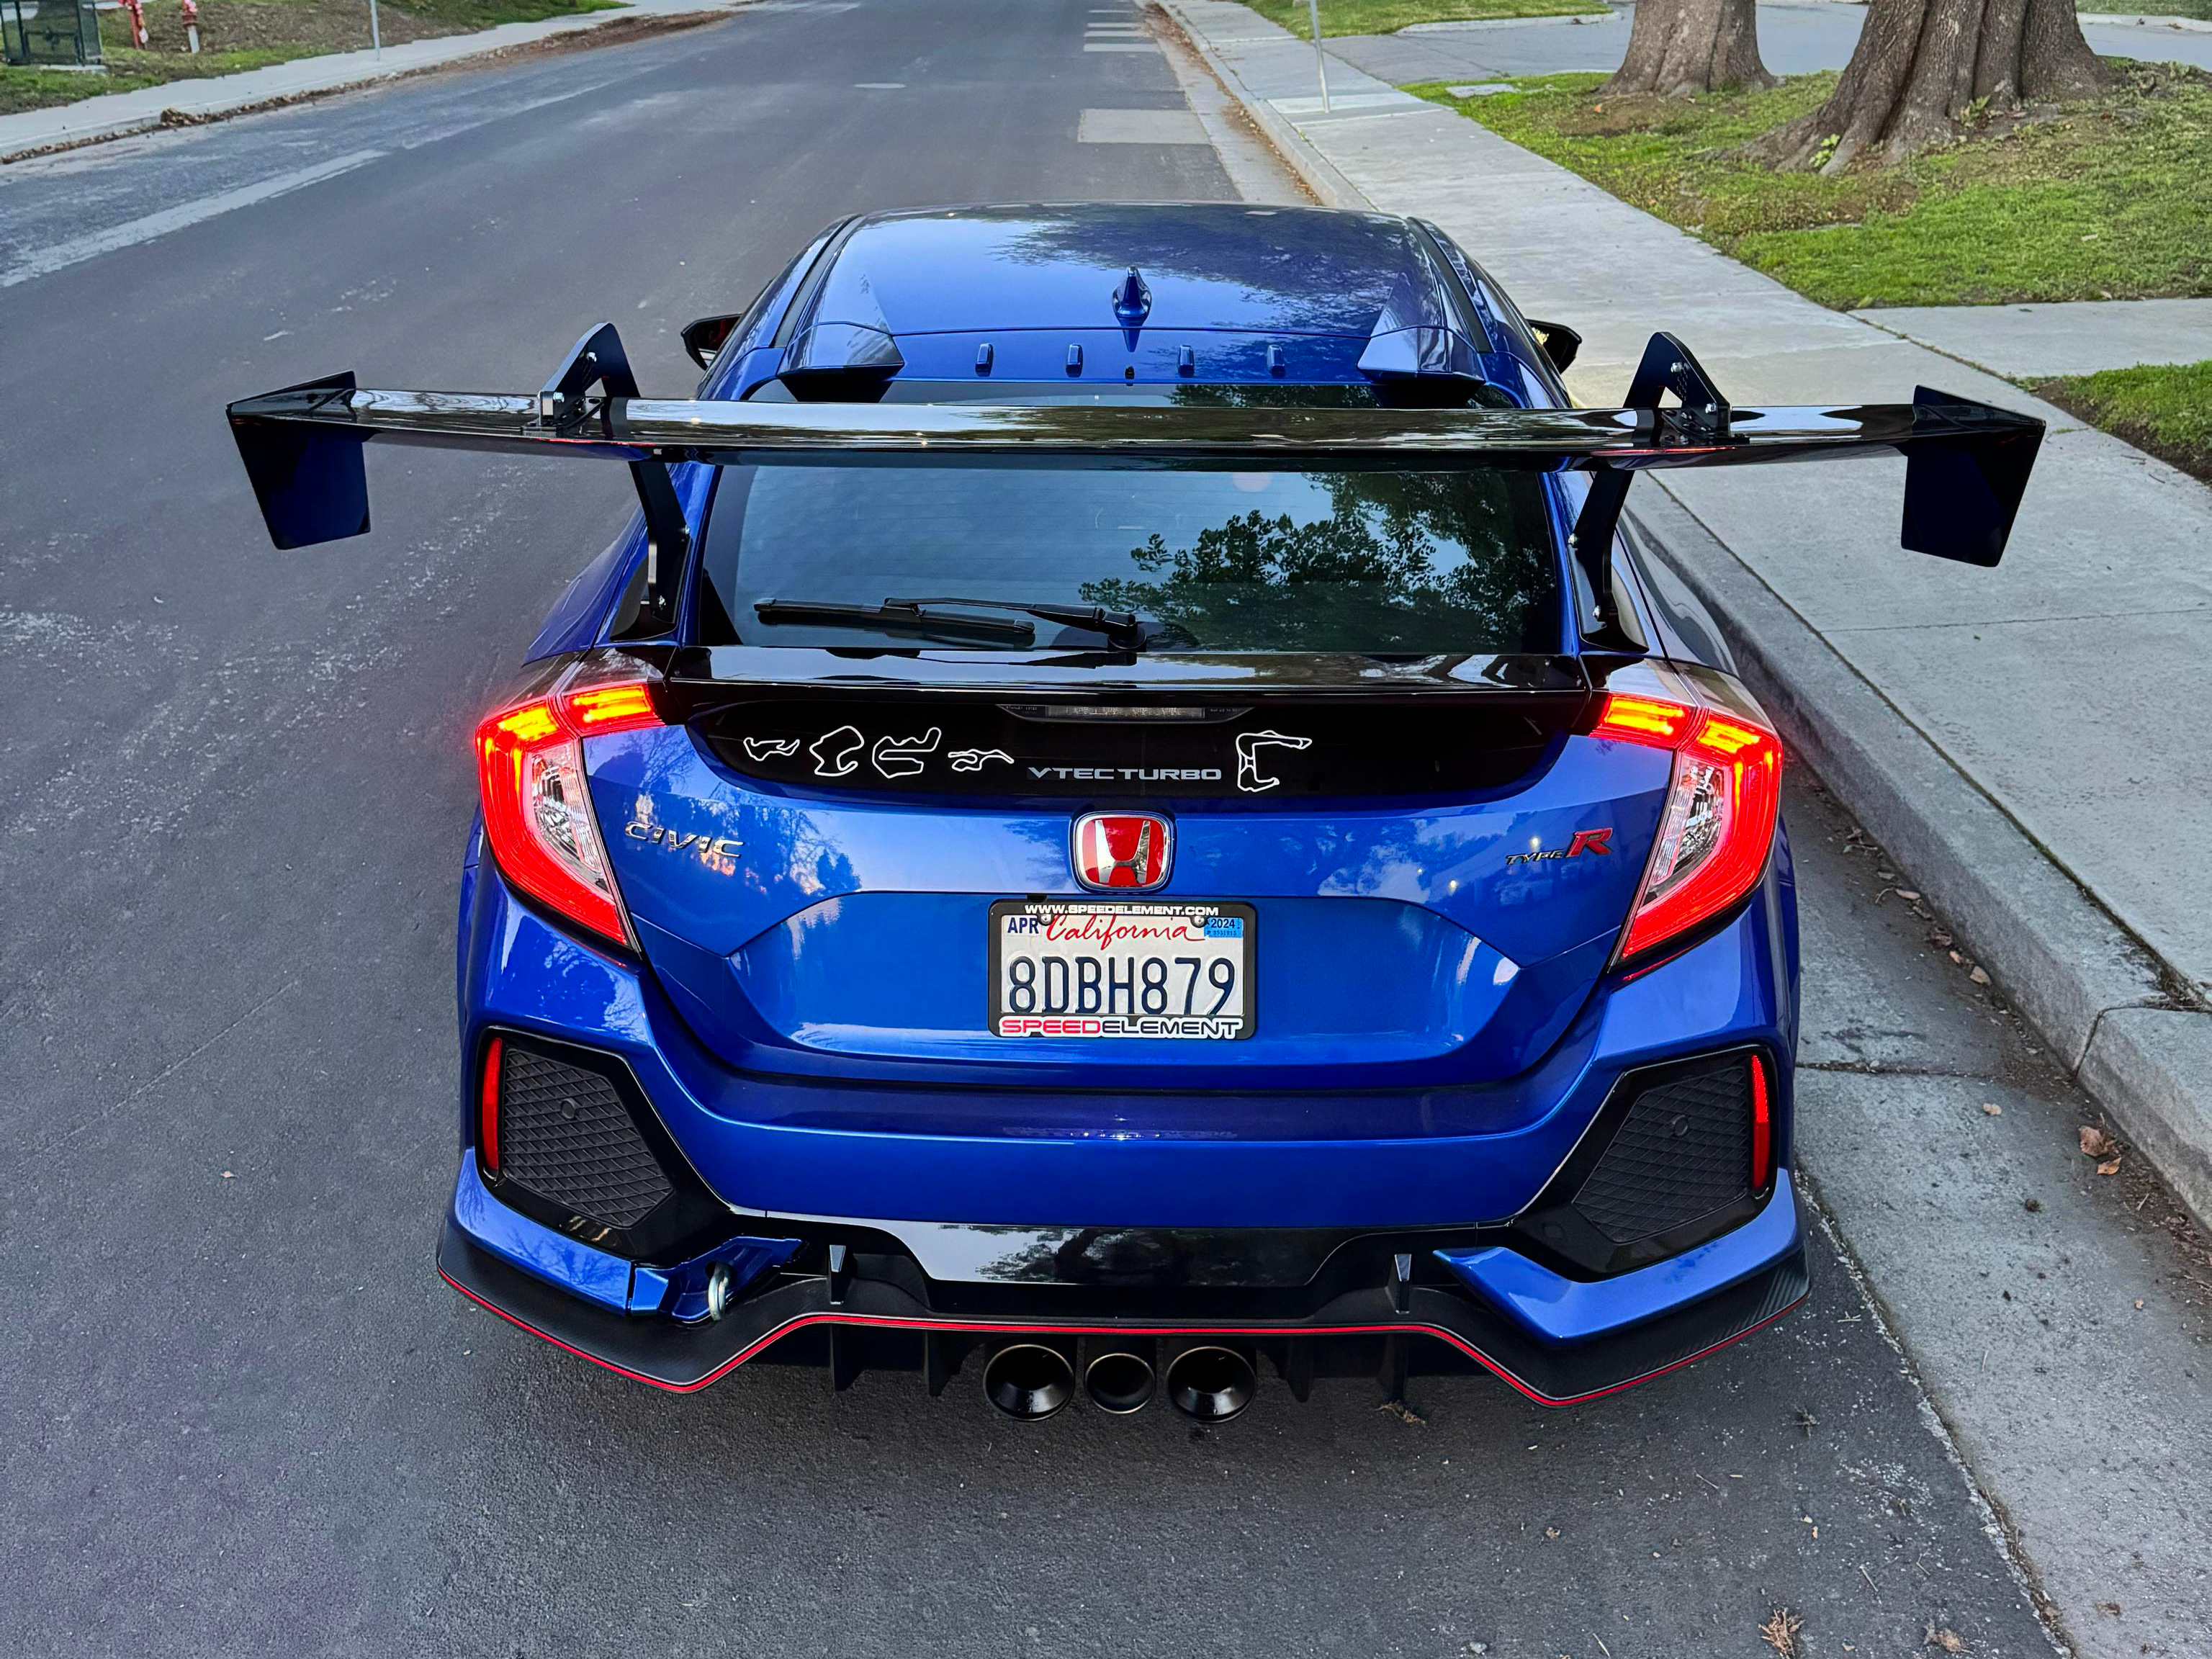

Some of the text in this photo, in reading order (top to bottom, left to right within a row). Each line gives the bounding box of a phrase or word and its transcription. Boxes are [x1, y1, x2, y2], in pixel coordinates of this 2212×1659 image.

[1028, 767, 1222, 781] VTEC TURBO
[624, 821, 745, 858] CIVIC
[1506, 827, 1613, 865] TYPE R
[1025, 904, 1219, 917] WWW.SPEEDELEMENT.COM
[1007, 917, 1039, 935] APR
[1046, 913, 1206, 950] California
[1210, 918, 1235, 929] 2024
[1009, 955, 1236, 1016] 8DBH879
[1001, 1018, 1241, 1038] SPEEDELEMENT
